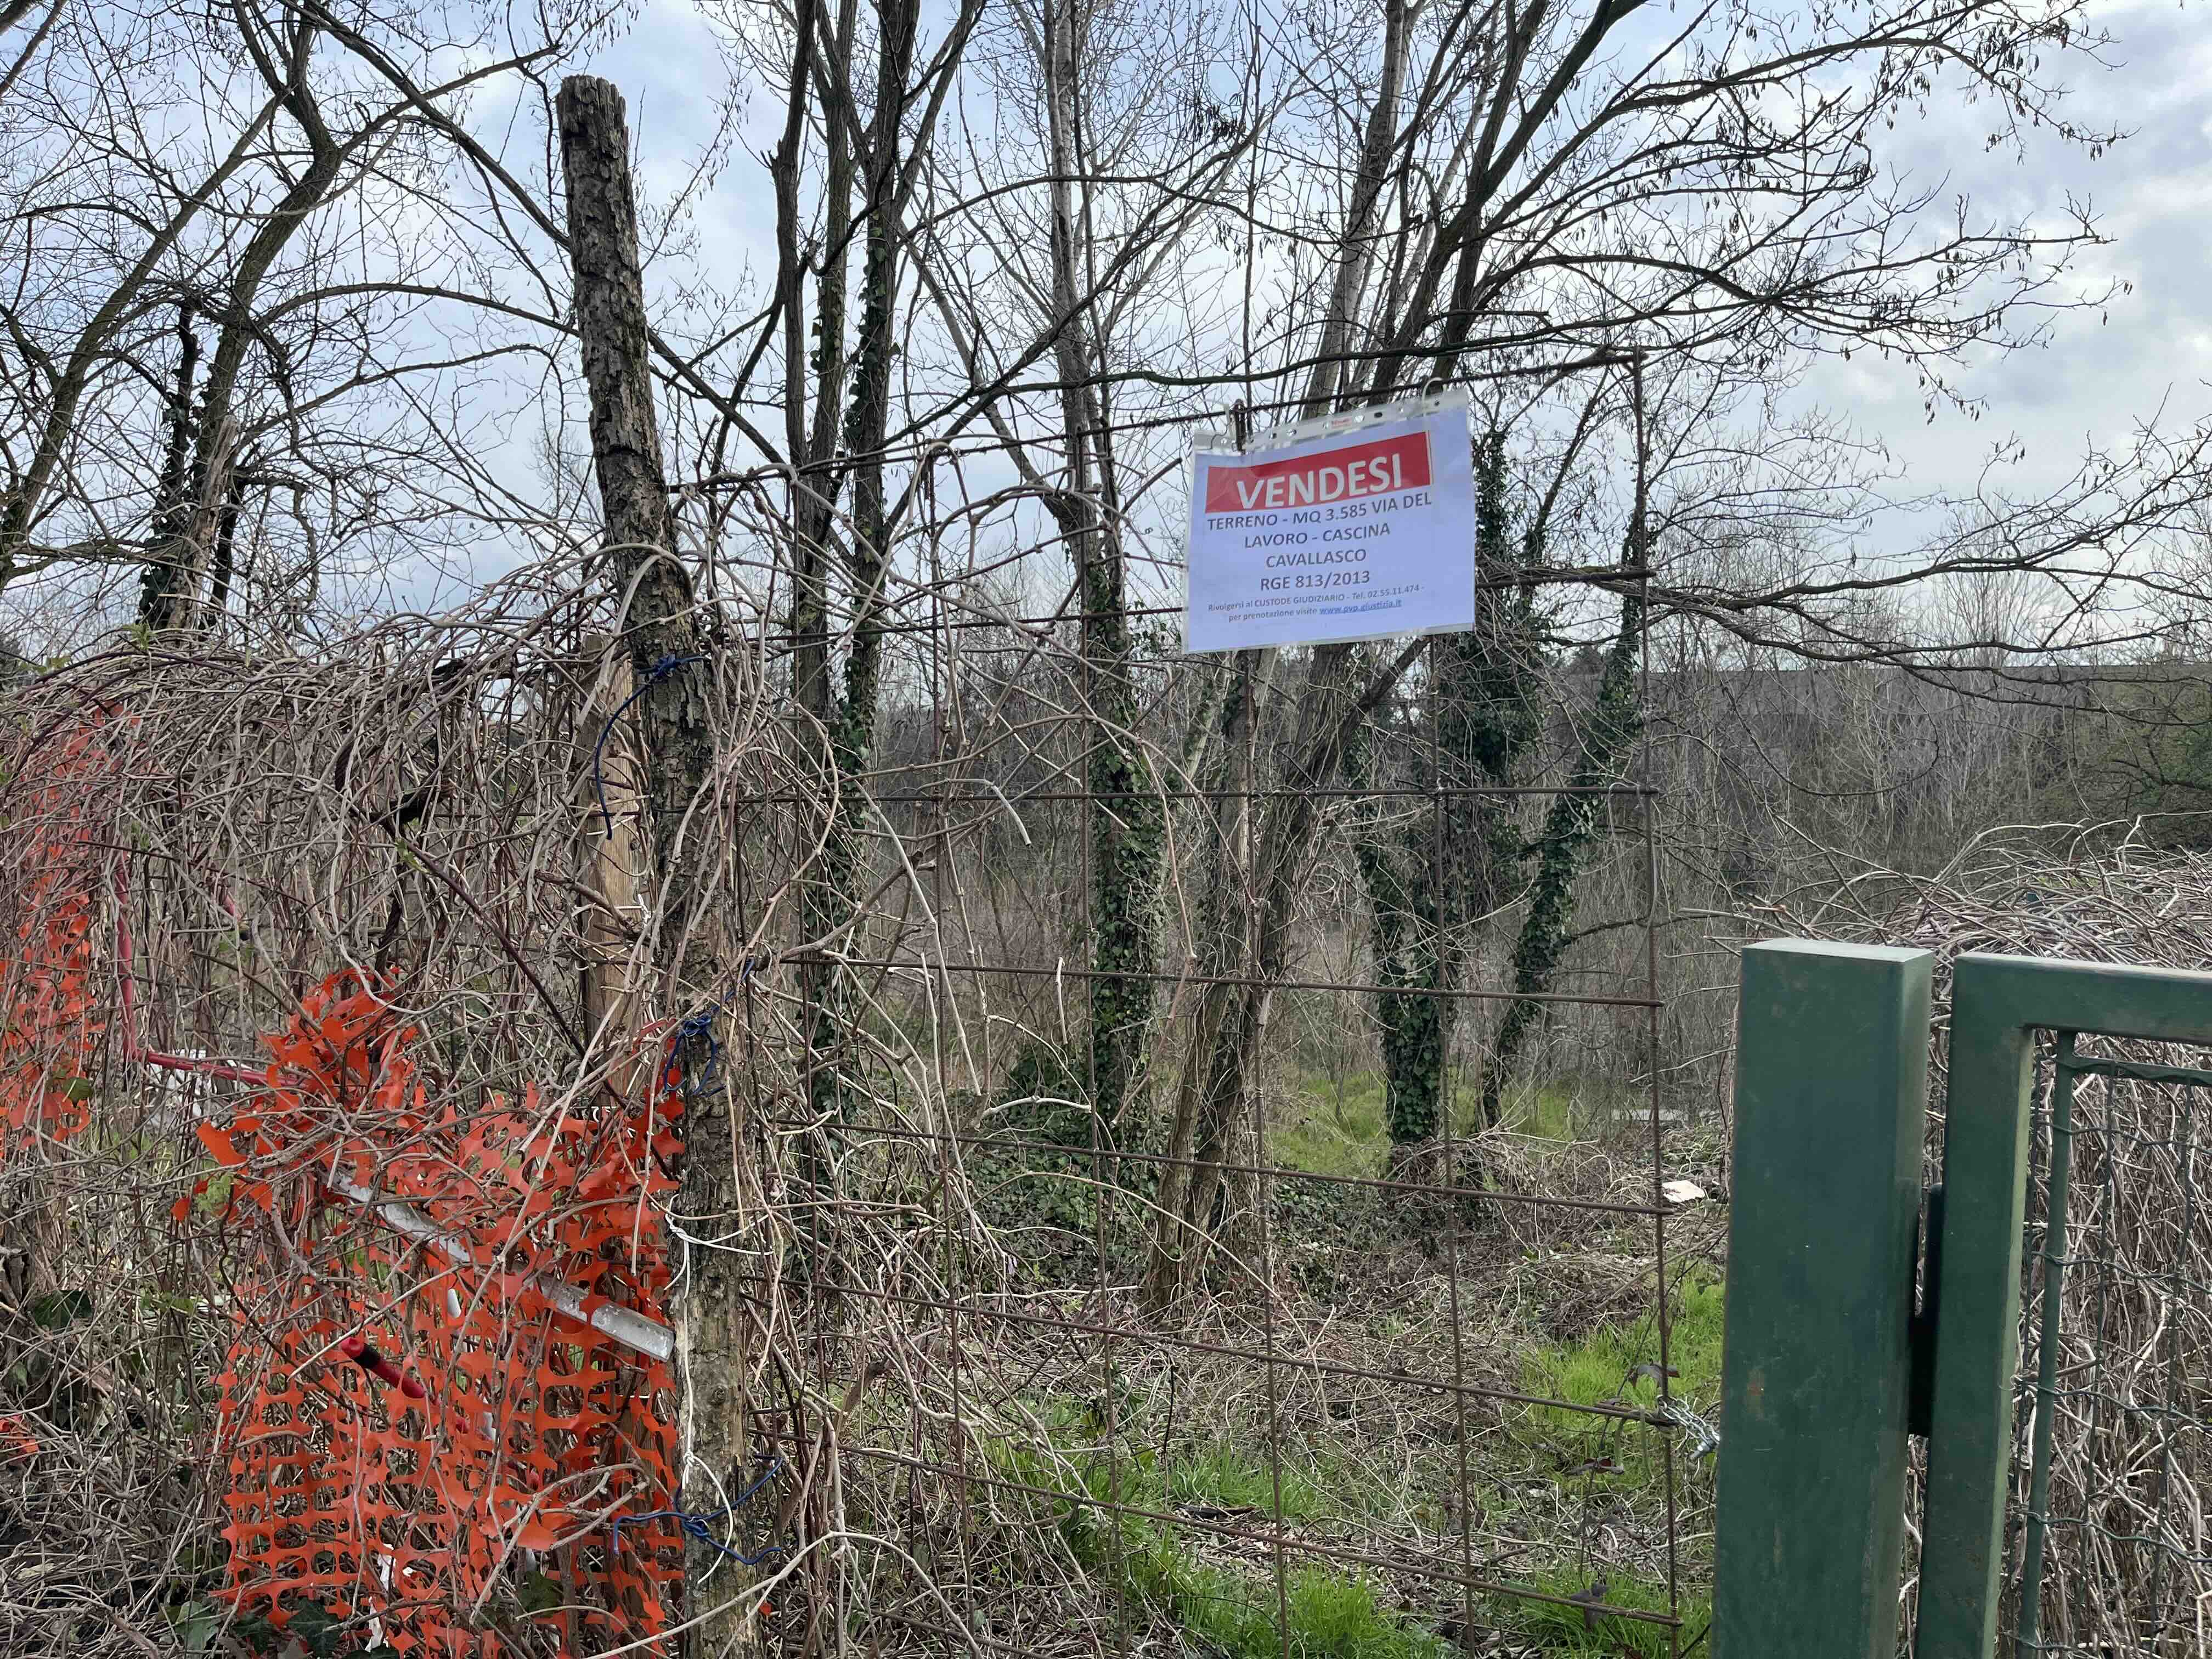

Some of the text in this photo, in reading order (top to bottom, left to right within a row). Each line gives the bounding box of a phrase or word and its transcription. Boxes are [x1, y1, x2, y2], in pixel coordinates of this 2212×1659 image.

[1237, 453, 1402, 510] VENDESI
[1207, 514, 1278, 531] TERRENO
[1293, 511, 1321, 524] MQ
[1325, 503, 1367, 521] 3.585
[1372, 498, 1398, 514] VIA
[1403, 492, 1431, 509] DEL
[1245, 532, 1307, 548] LAVORO
[1323, 523, 1390, 541] CASCINA
[1266, 549, 1367, 568] CAVALLASCO
[1260, 570, 1370, 591] RGE 813/2013
[1208, 601, 1244, 612] Rivolgersi
[1255, 597, 1291, 607] CUSTODE
[1293, 594, 1345, 604] GIUDIZIARIO
[1228, 614, 1241, 623] per
[1243, 609, 1294, 621] prenotazione
